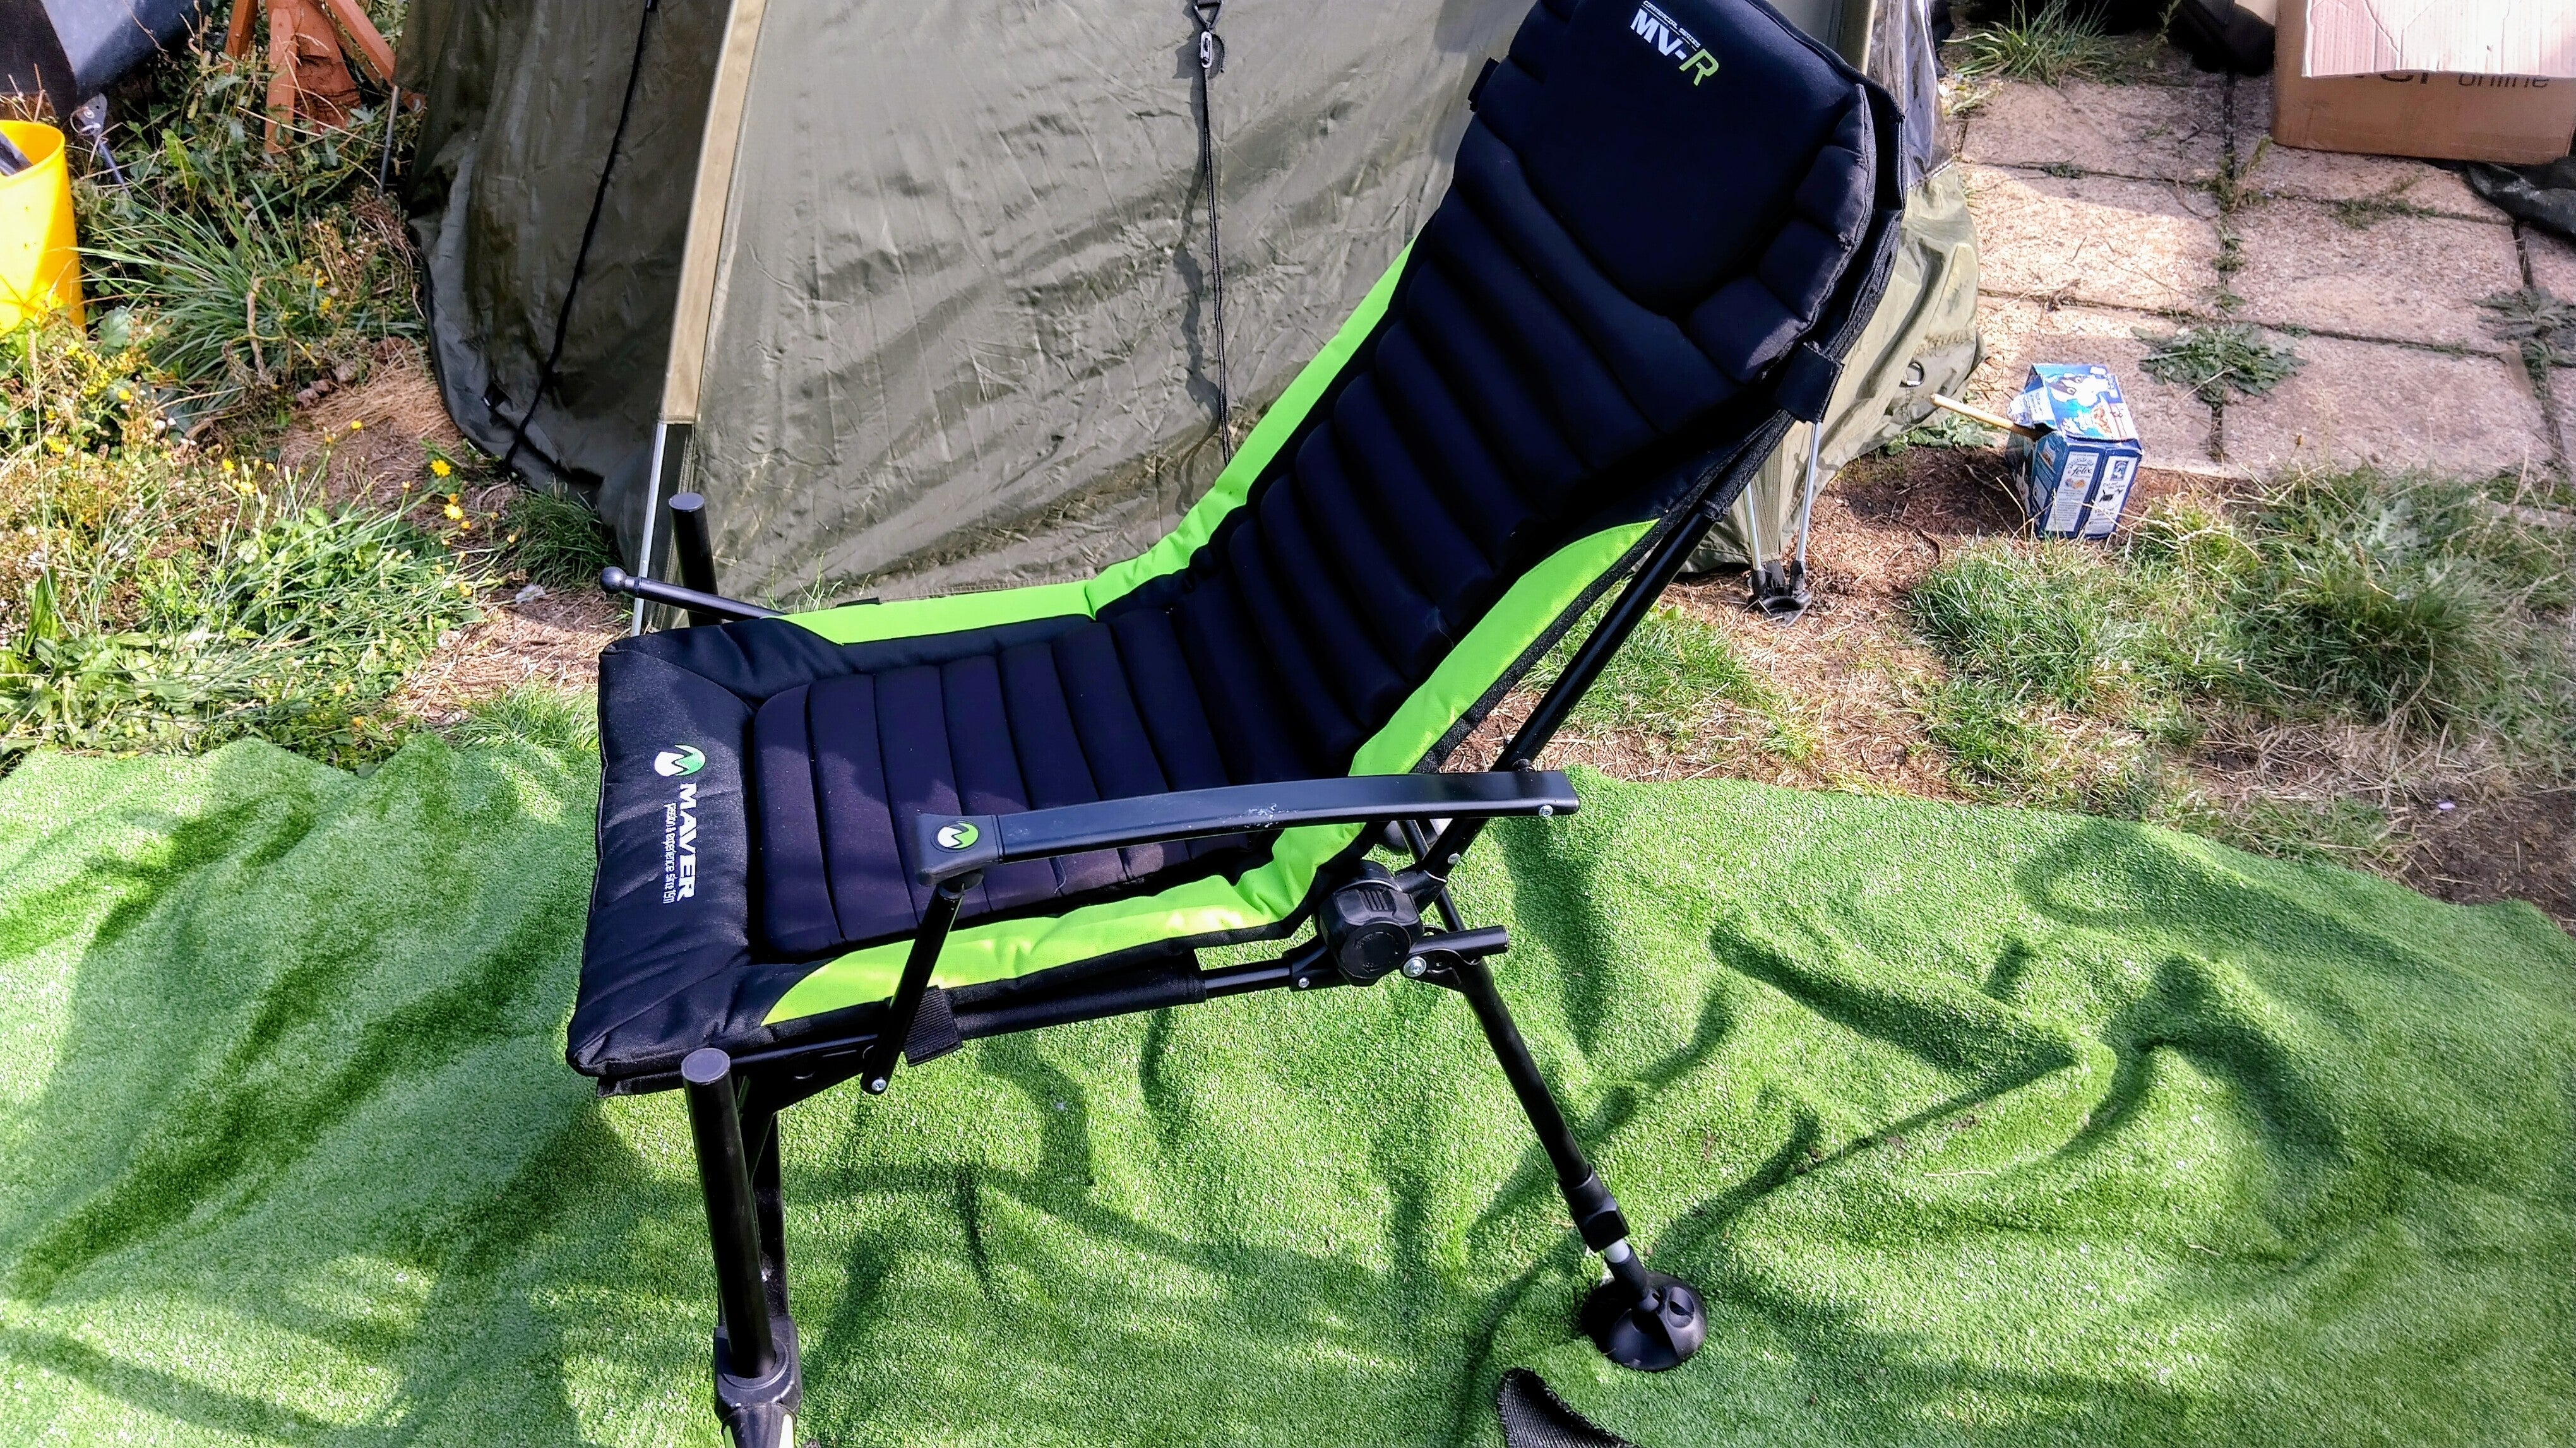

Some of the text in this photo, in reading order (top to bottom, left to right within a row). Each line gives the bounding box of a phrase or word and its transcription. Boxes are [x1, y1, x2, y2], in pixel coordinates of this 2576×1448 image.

[1630, 8, 1719, 86] MV-R
[662, 833, 676, 872] experience
[677, 783, 696, 901] MAVER
